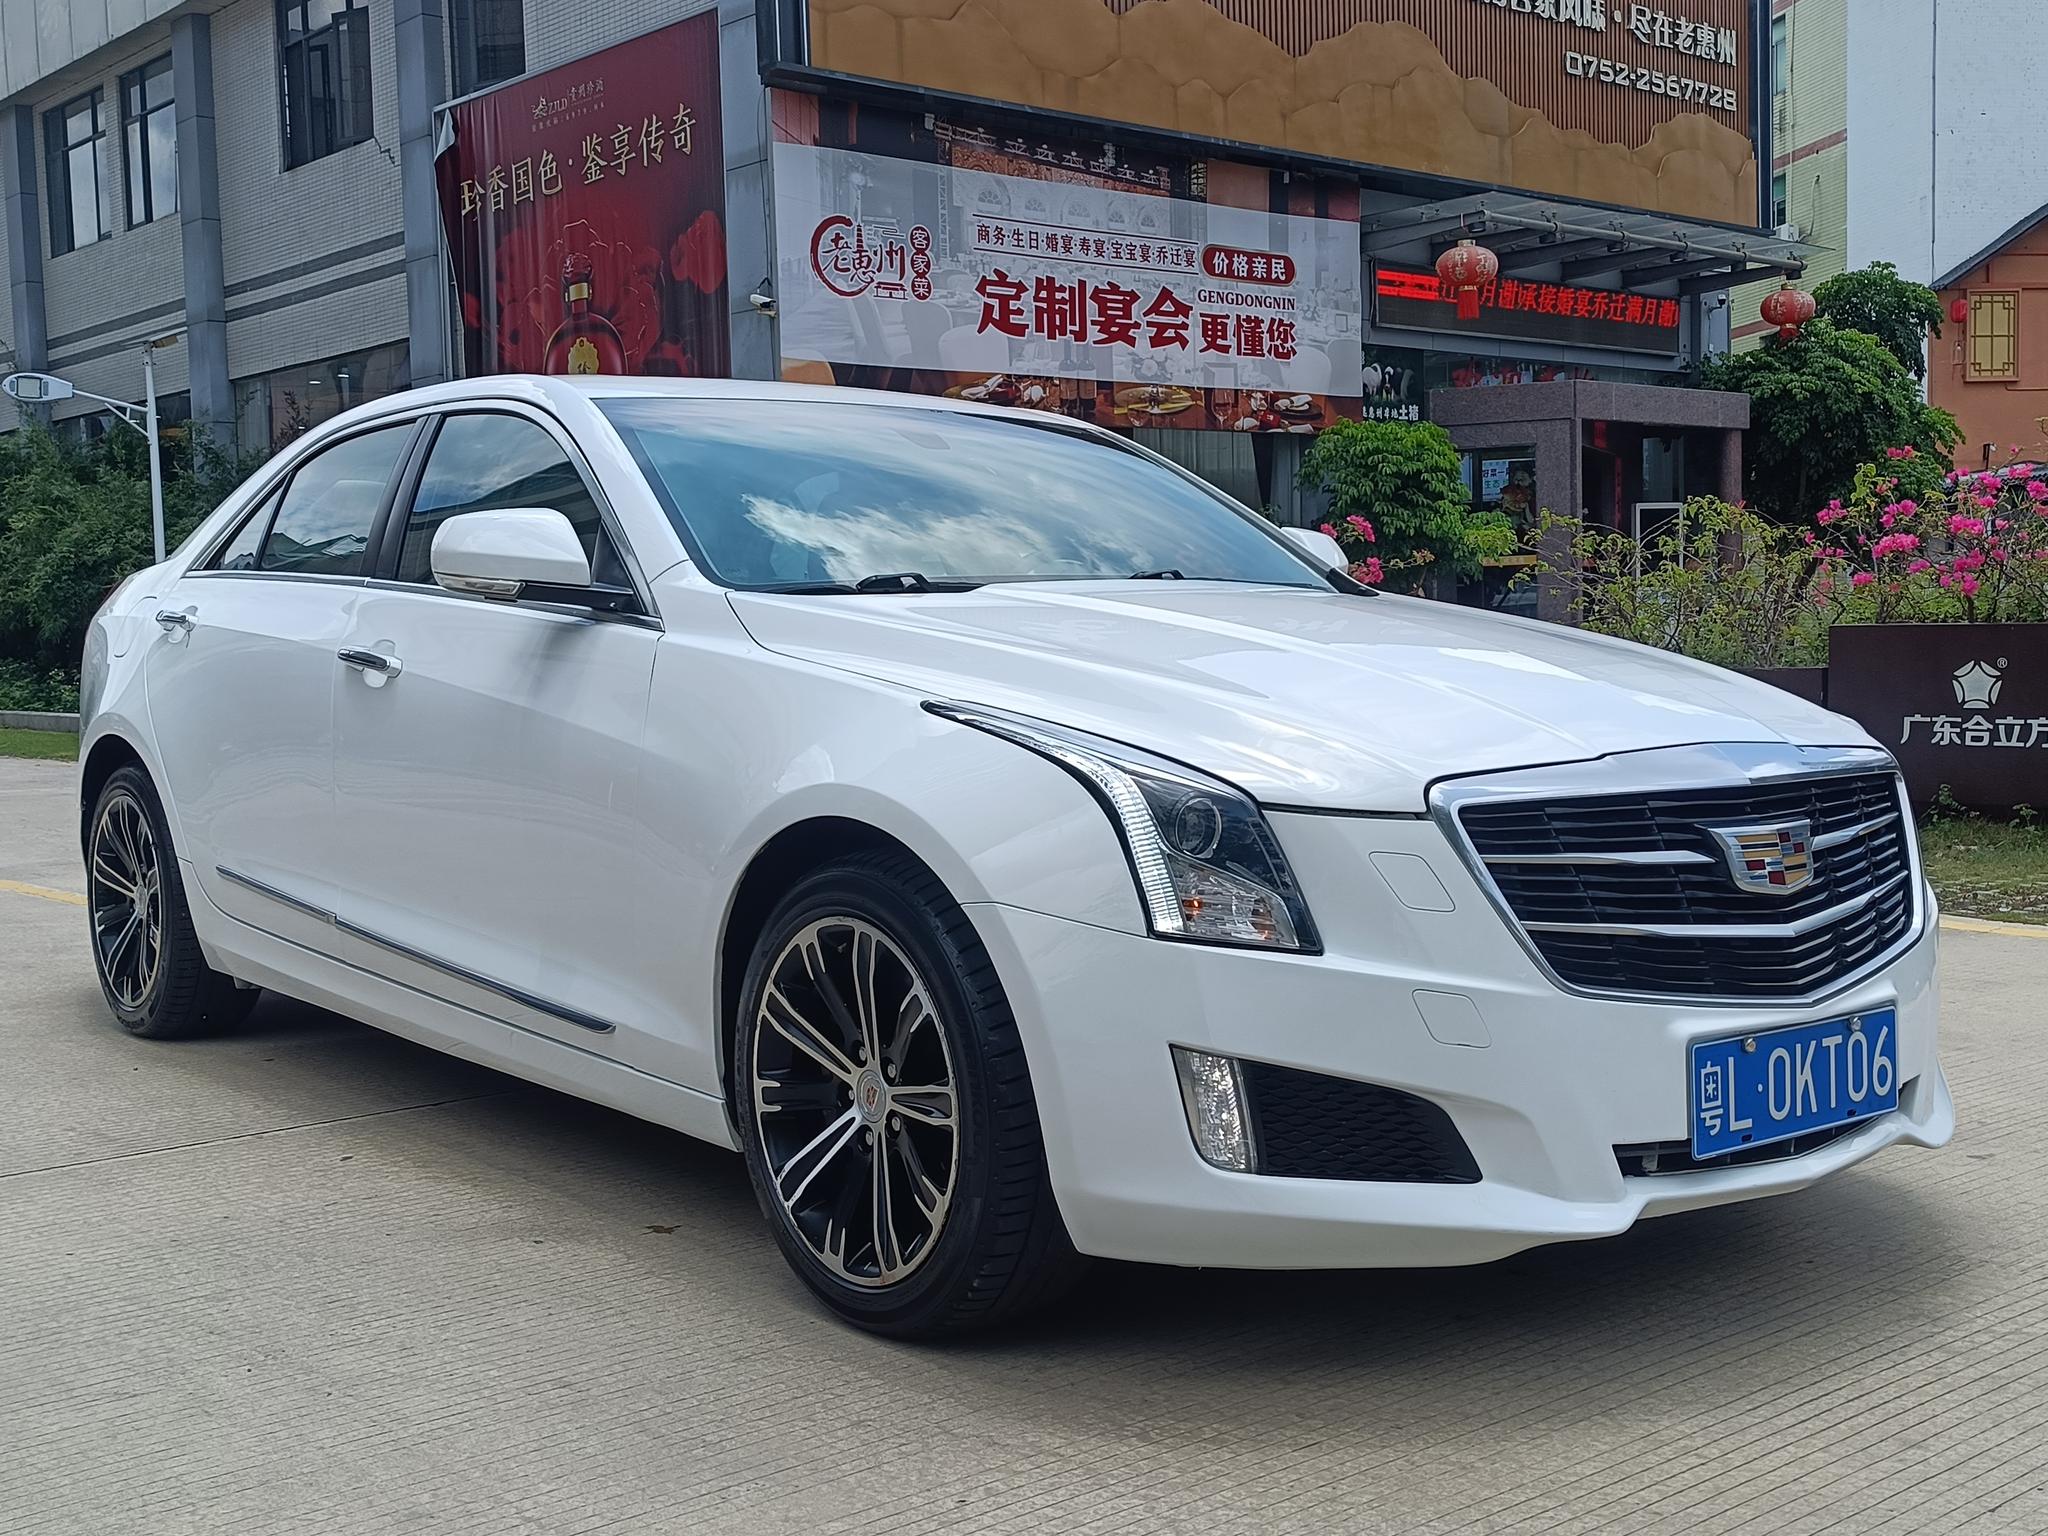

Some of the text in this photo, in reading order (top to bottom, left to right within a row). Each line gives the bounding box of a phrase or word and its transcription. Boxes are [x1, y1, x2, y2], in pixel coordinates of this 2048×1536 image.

[1565, 51, 1737, 111] 0752-2567728
[820, 224, 906, 285] 老惠州
[912, 229, 930, 297] 客家菜
[1212, 251, 1287, 281] 价格亲民
[974, 268, 1298, 361] 定制宴会 更懂您
[1198, 289, 1296, 311] GENGDONGNIN
[1900, 714, 2048, 748] 广东合立方
